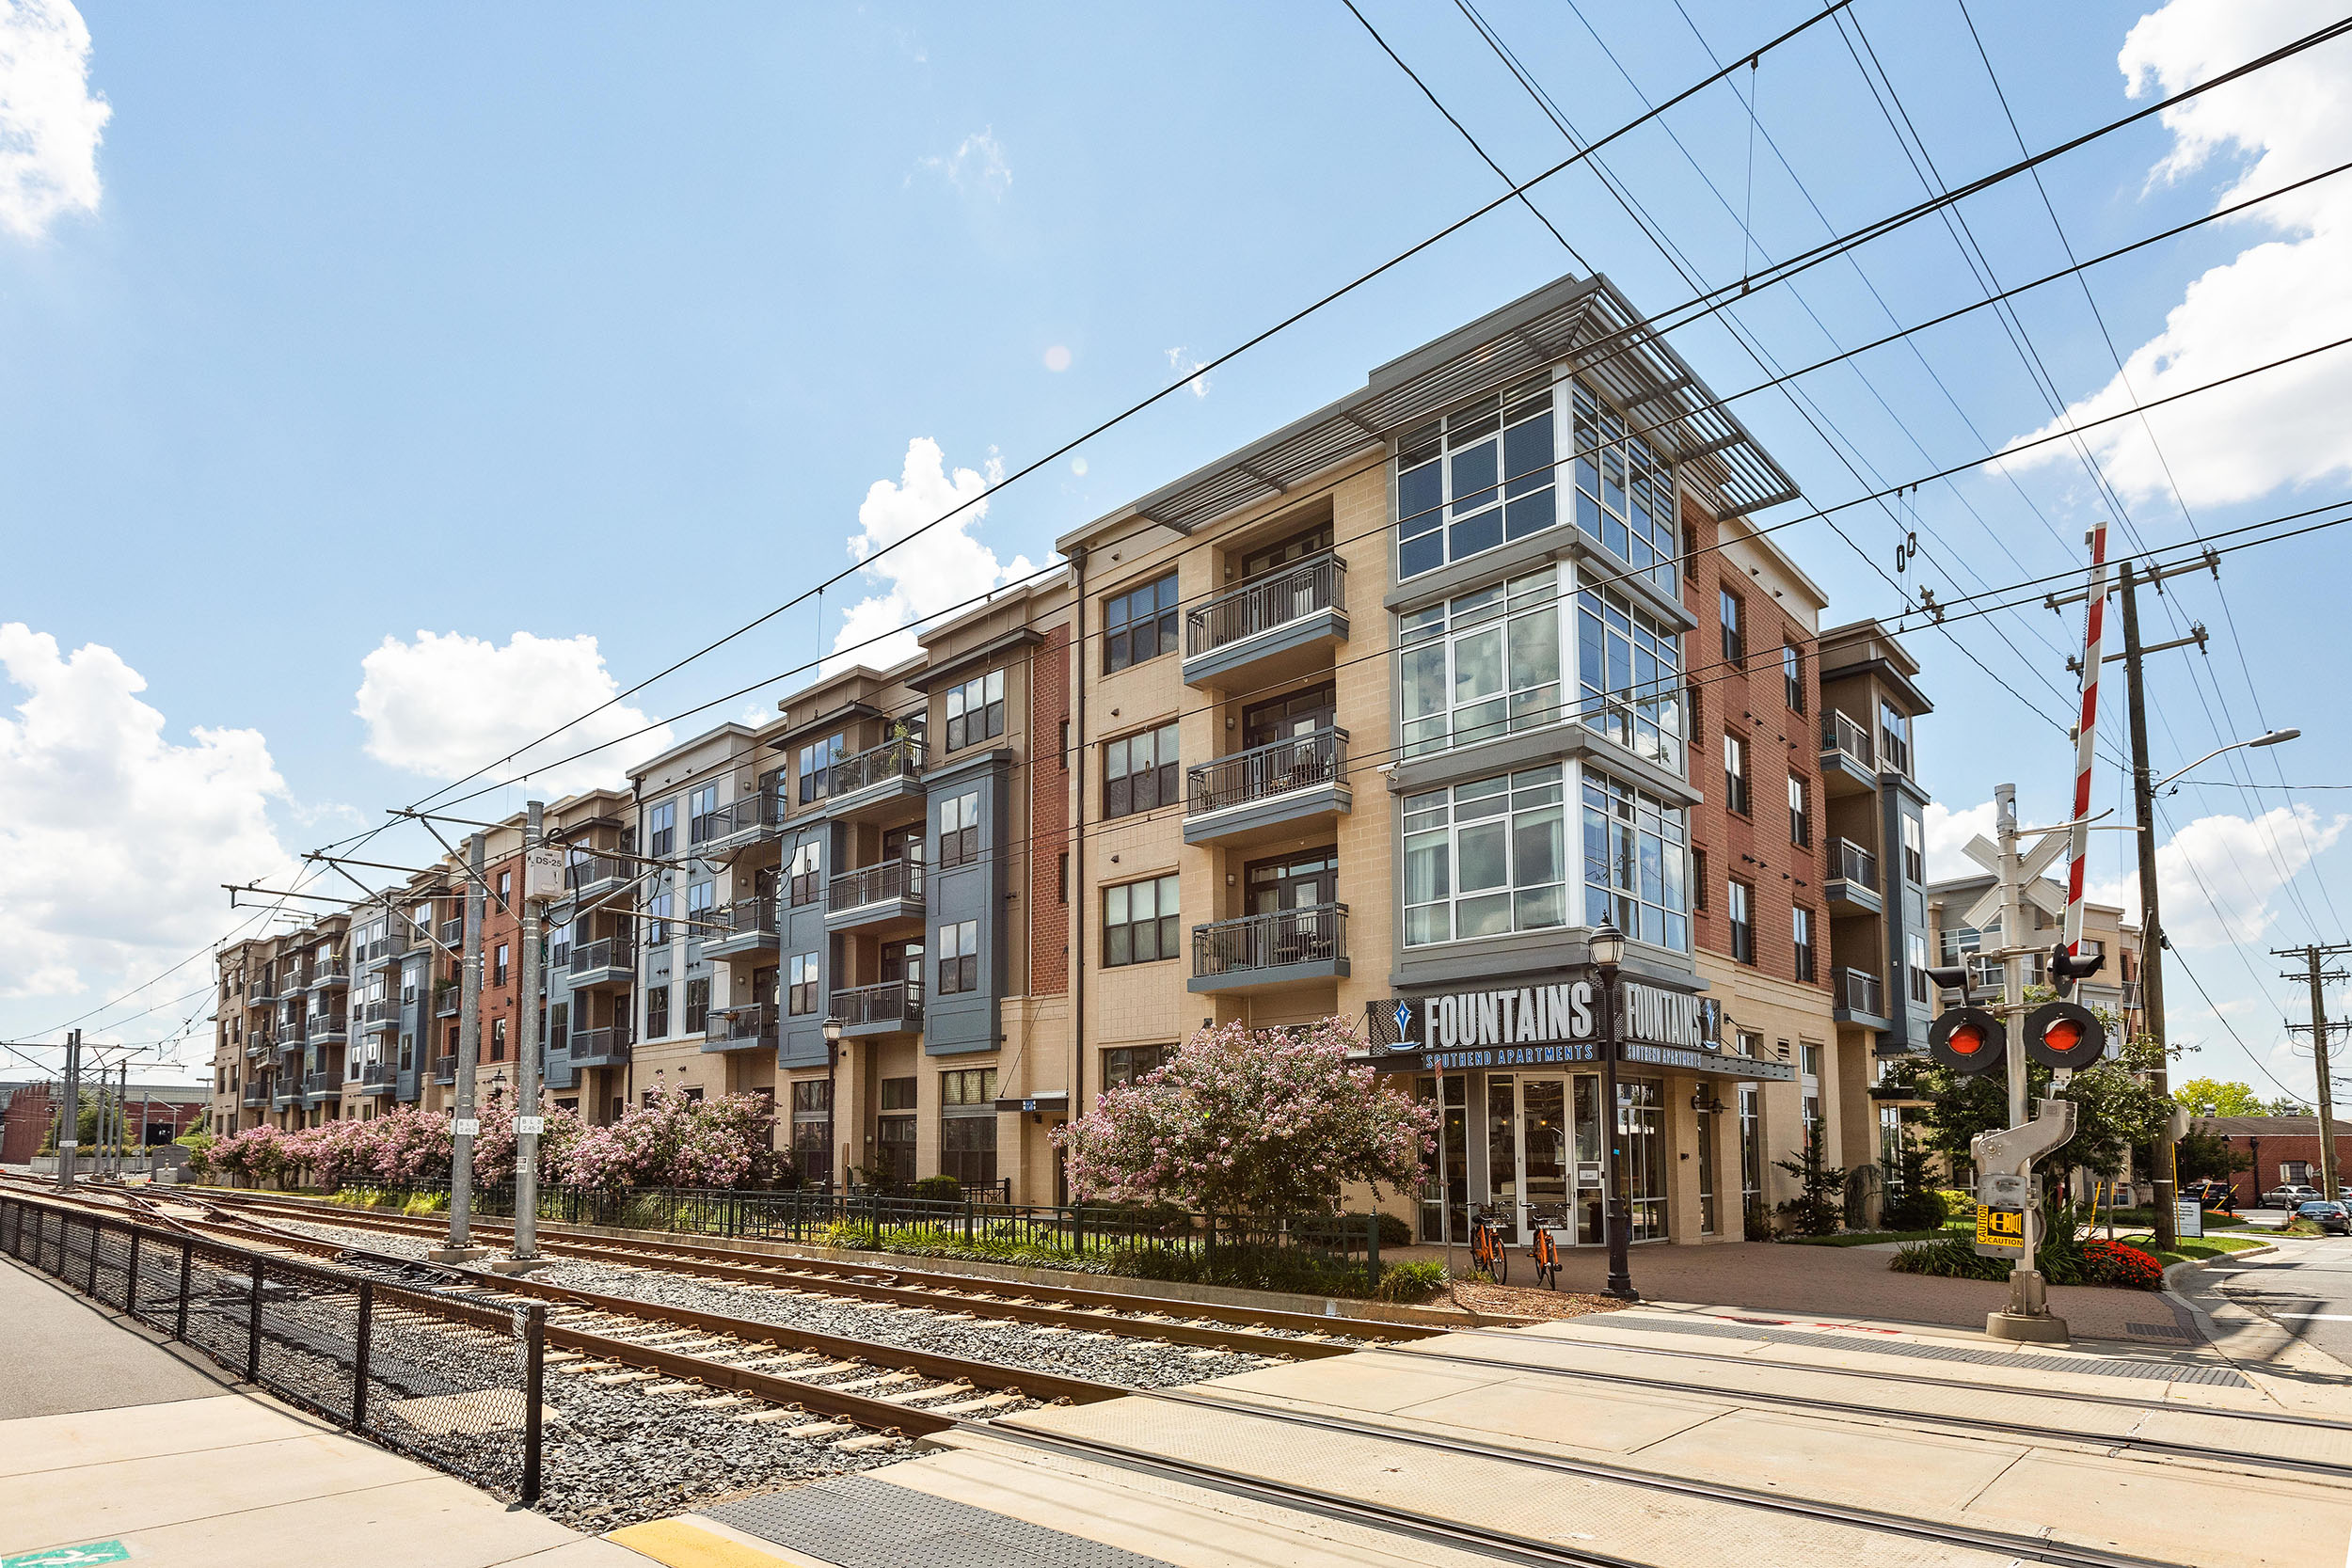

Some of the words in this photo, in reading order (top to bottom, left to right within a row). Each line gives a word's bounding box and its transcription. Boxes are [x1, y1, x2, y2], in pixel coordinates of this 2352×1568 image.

[536, 856, 562, 867] DS-25
[1424, 981, 1593, 1049] FOUNTAINS
[1625, 981, 1702, 1048] FOUNTAINS
[1498, 1044, 1594, 1065] APARTMENTS
[1979, 1205, 1987, 1243] CAUTION
[1987, 1237, 2023, 1246] CAUTION
